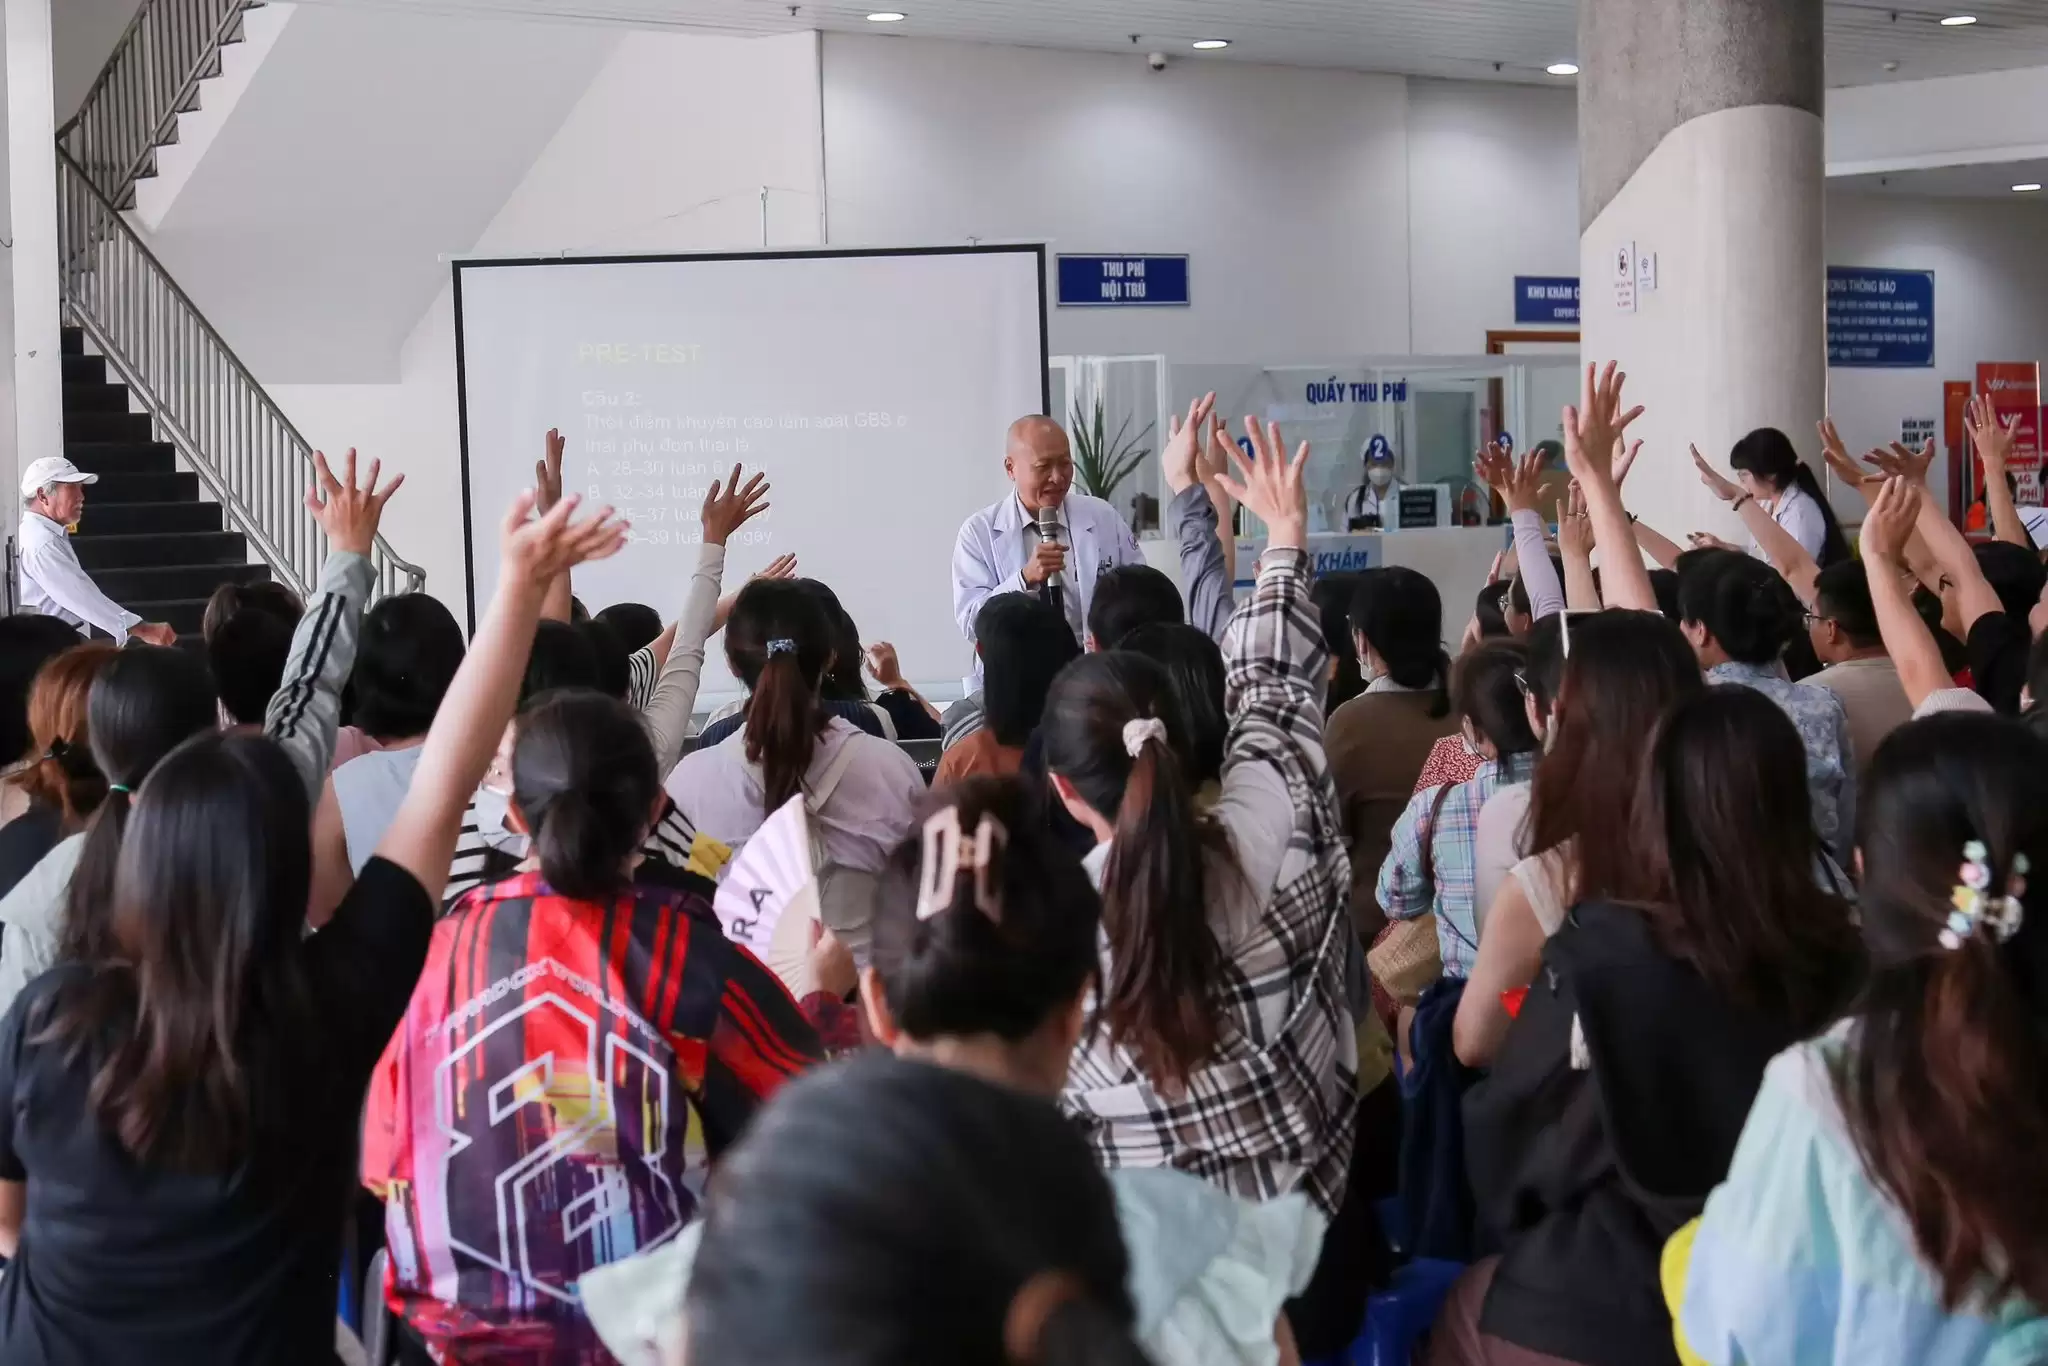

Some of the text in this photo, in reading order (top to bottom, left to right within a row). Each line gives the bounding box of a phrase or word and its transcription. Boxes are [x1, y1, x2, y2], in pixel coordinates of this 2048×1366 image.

[1102, 259, 1145, 277] THU PHÍ
[1101, 279, 1146, 301] NỘI TRÚ
[1528, 285, 1545, 299] KHU
[1547, 283, 1572, 300] KHÁM
[579, 343, 701, 364] PRE-TEST
[1349, 383, 1378, 402] THU
[1383, 377, 1406, 402] PHÍ
[1373, 438, 1385, 457] 2
[1318, 544, 1369, 571] KHÁM
